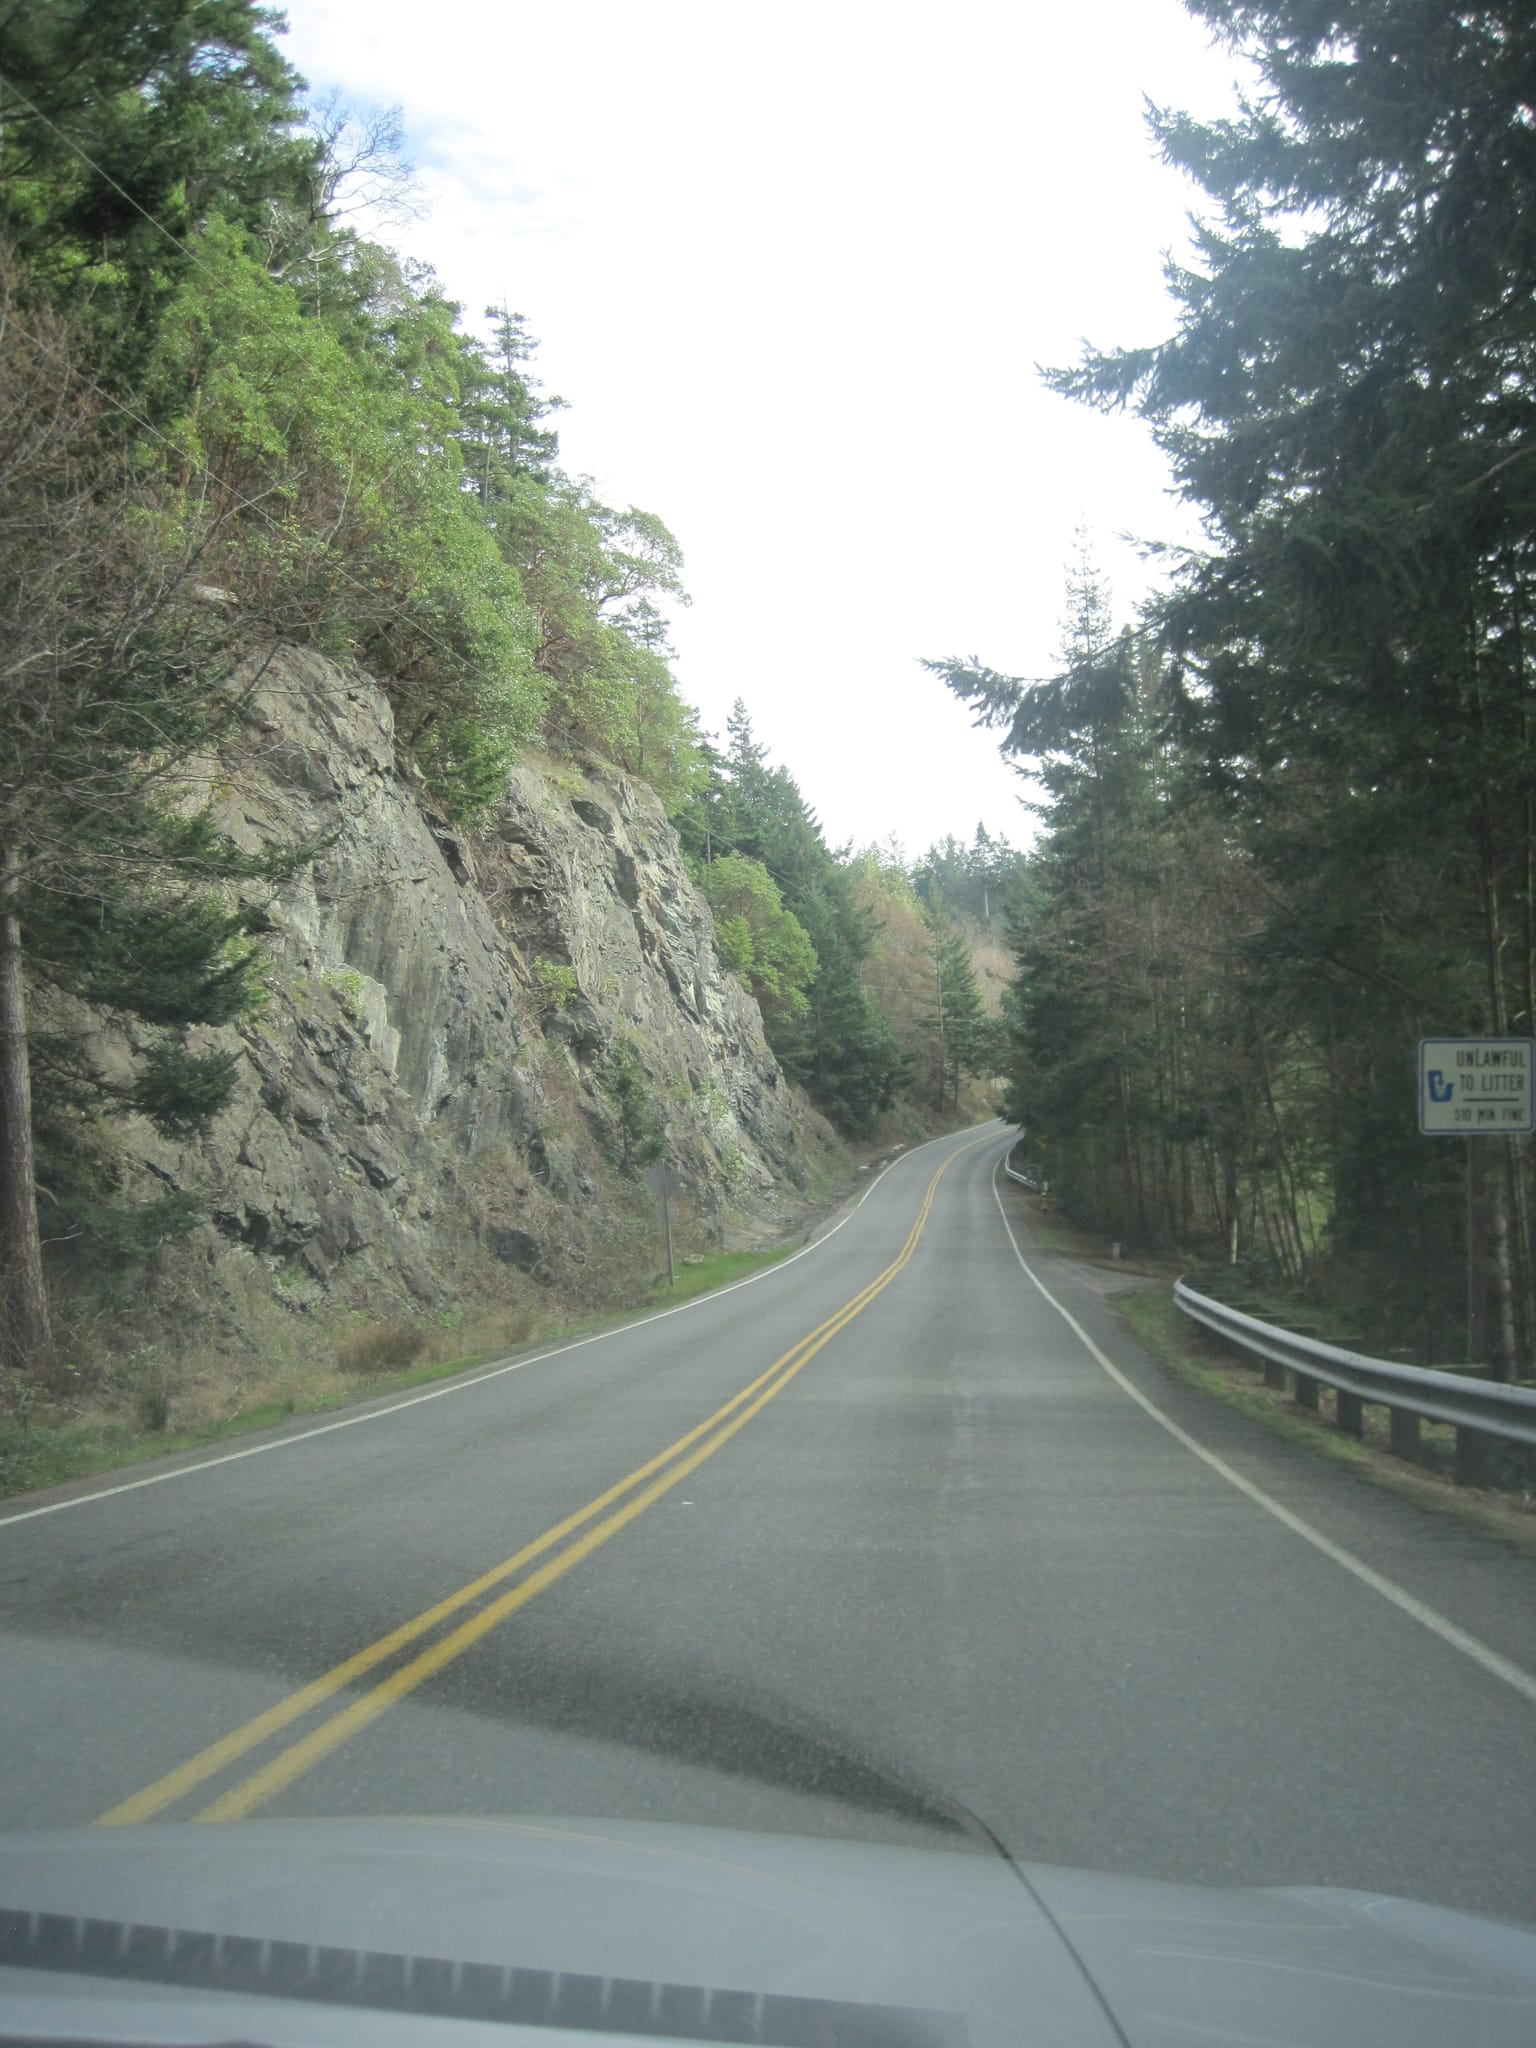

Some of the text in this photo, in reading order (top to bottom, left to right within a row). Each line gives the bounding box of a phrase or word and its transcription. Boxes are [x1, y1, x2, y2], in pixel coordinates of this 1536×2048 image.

[1455, 1050, 1527, 1068] UNLAWFUL
[1459, 1074, 1525, 1092] TO LITTER
